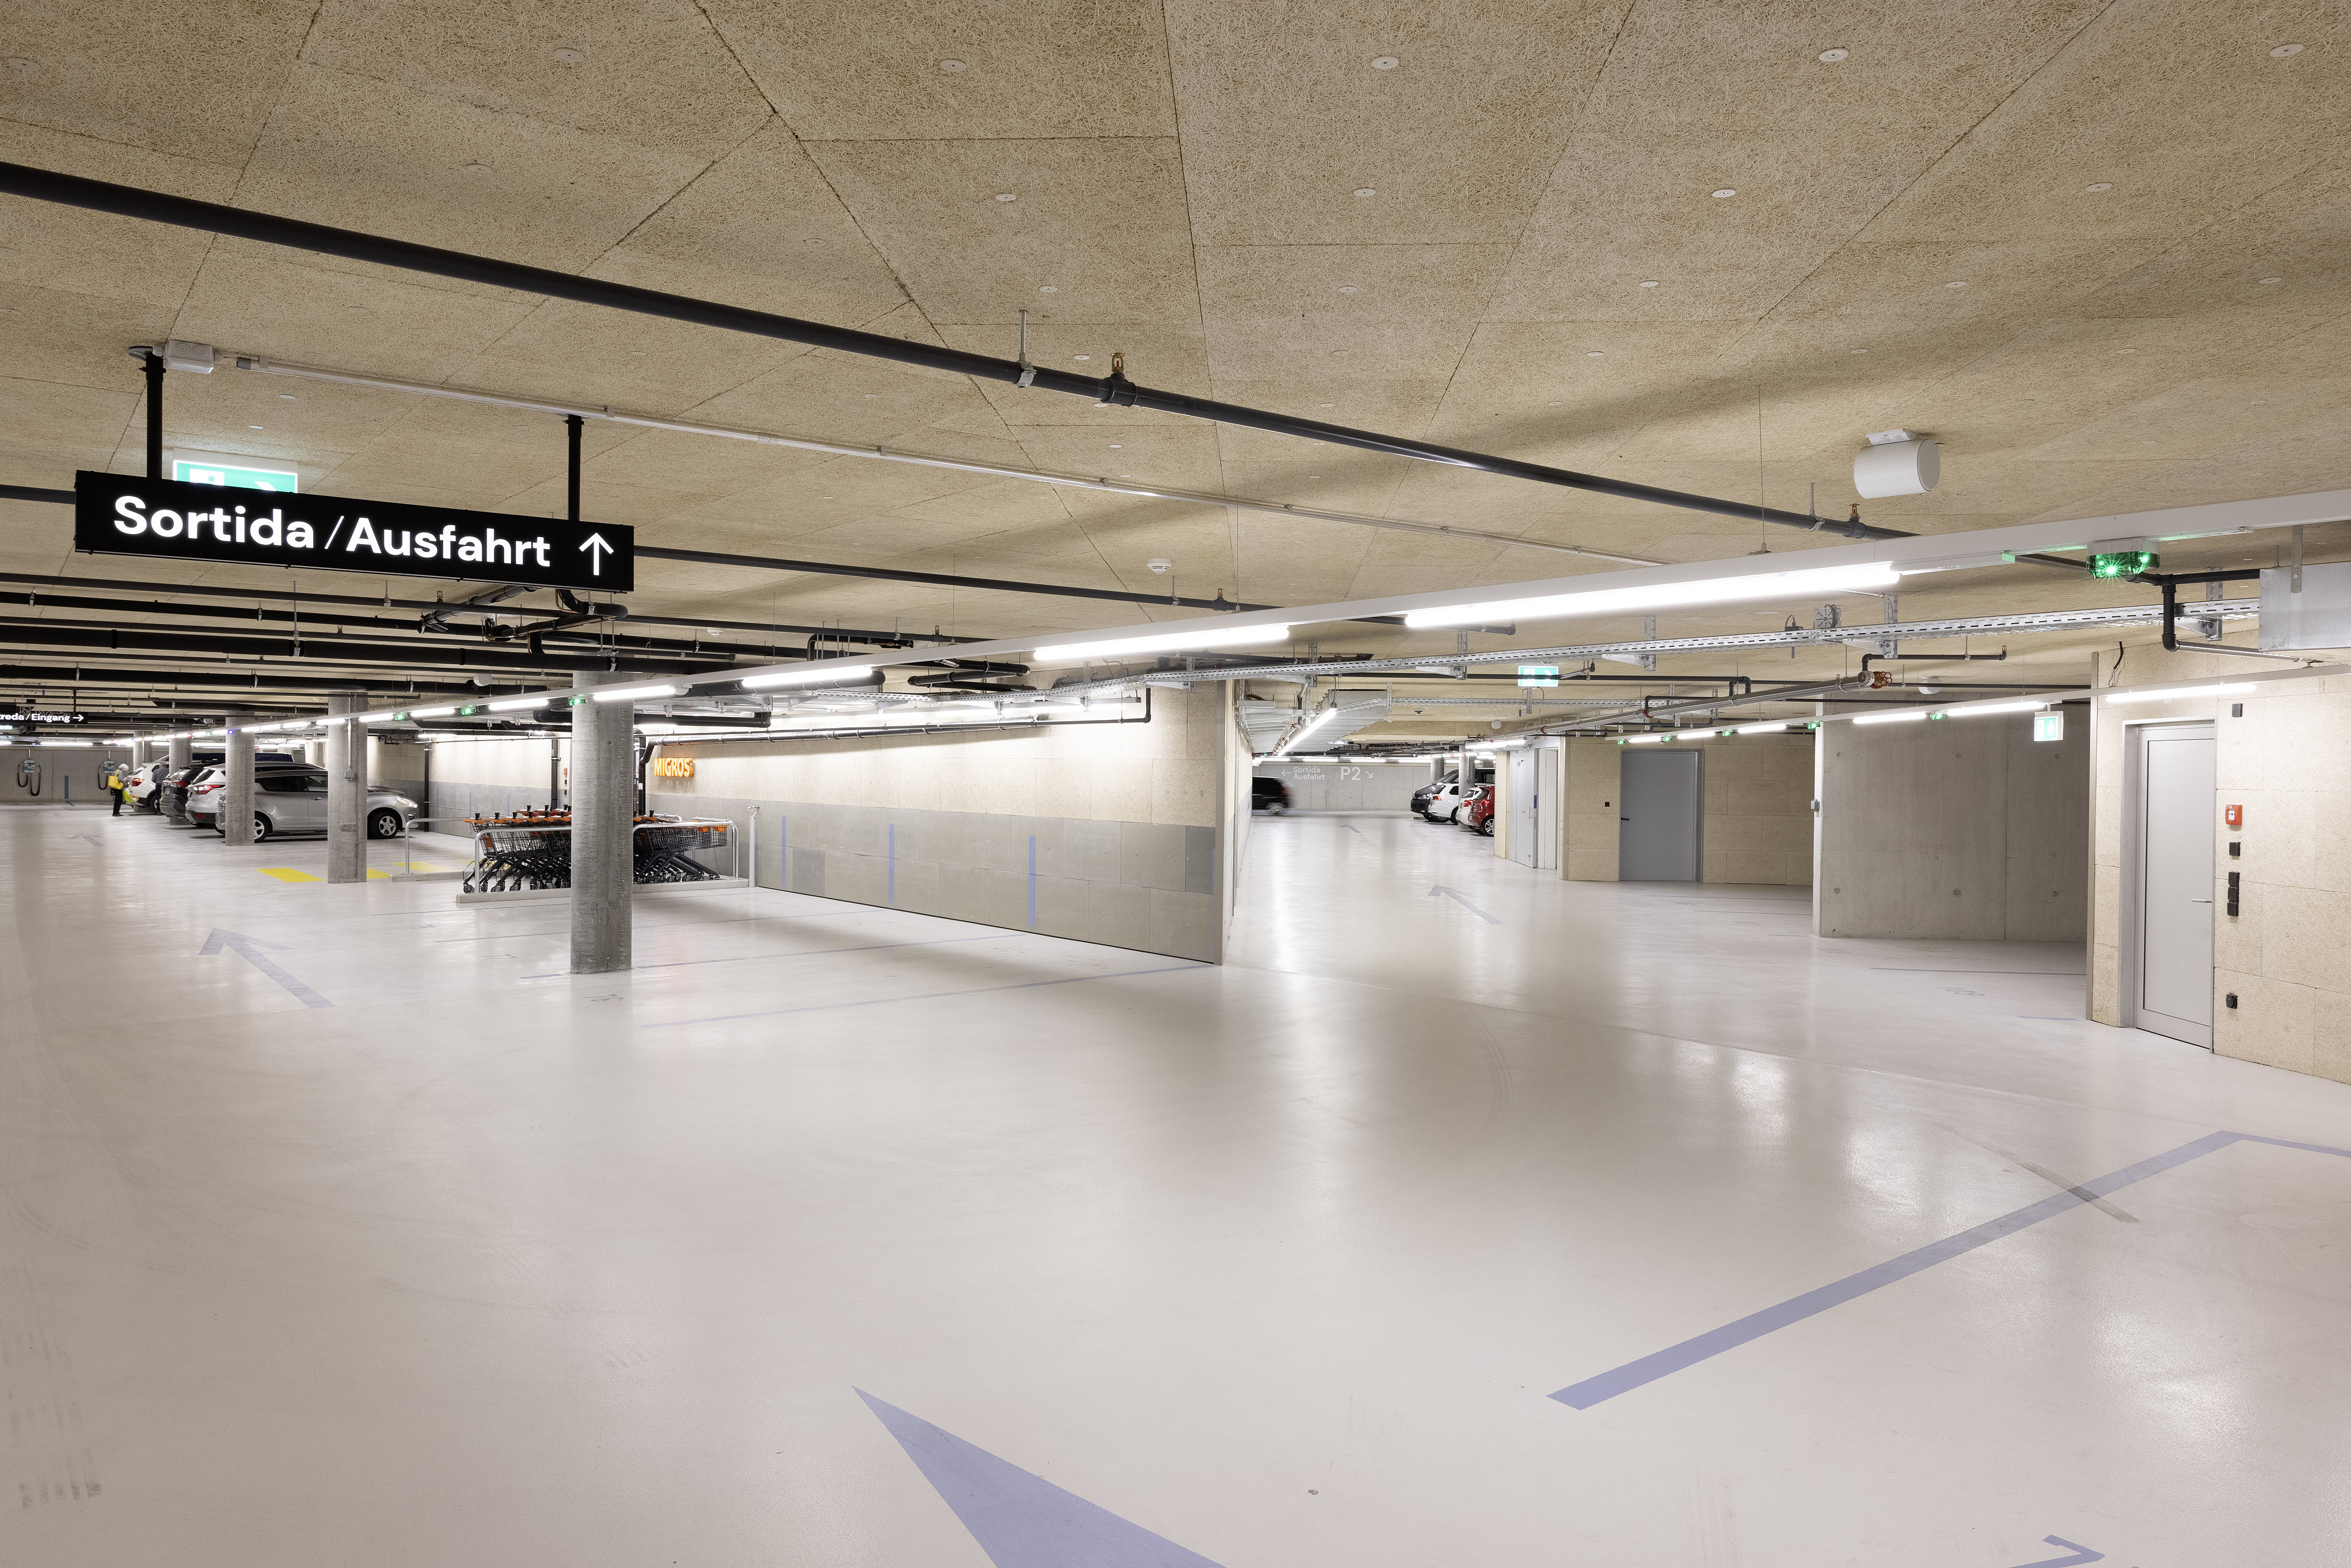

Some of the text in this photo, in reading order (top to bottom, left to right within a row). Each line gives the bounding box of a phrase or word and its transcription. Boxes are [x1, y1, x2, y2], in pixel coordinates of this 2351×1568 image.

[114, 495, 314, 549] Sortida
[345, 517, 551, 568] Ausfahrt
[31, 713, 70, 723] Eingang
[654, 758, 694, 778] MIGROS
[1341, 766, 1361, 780] P2
